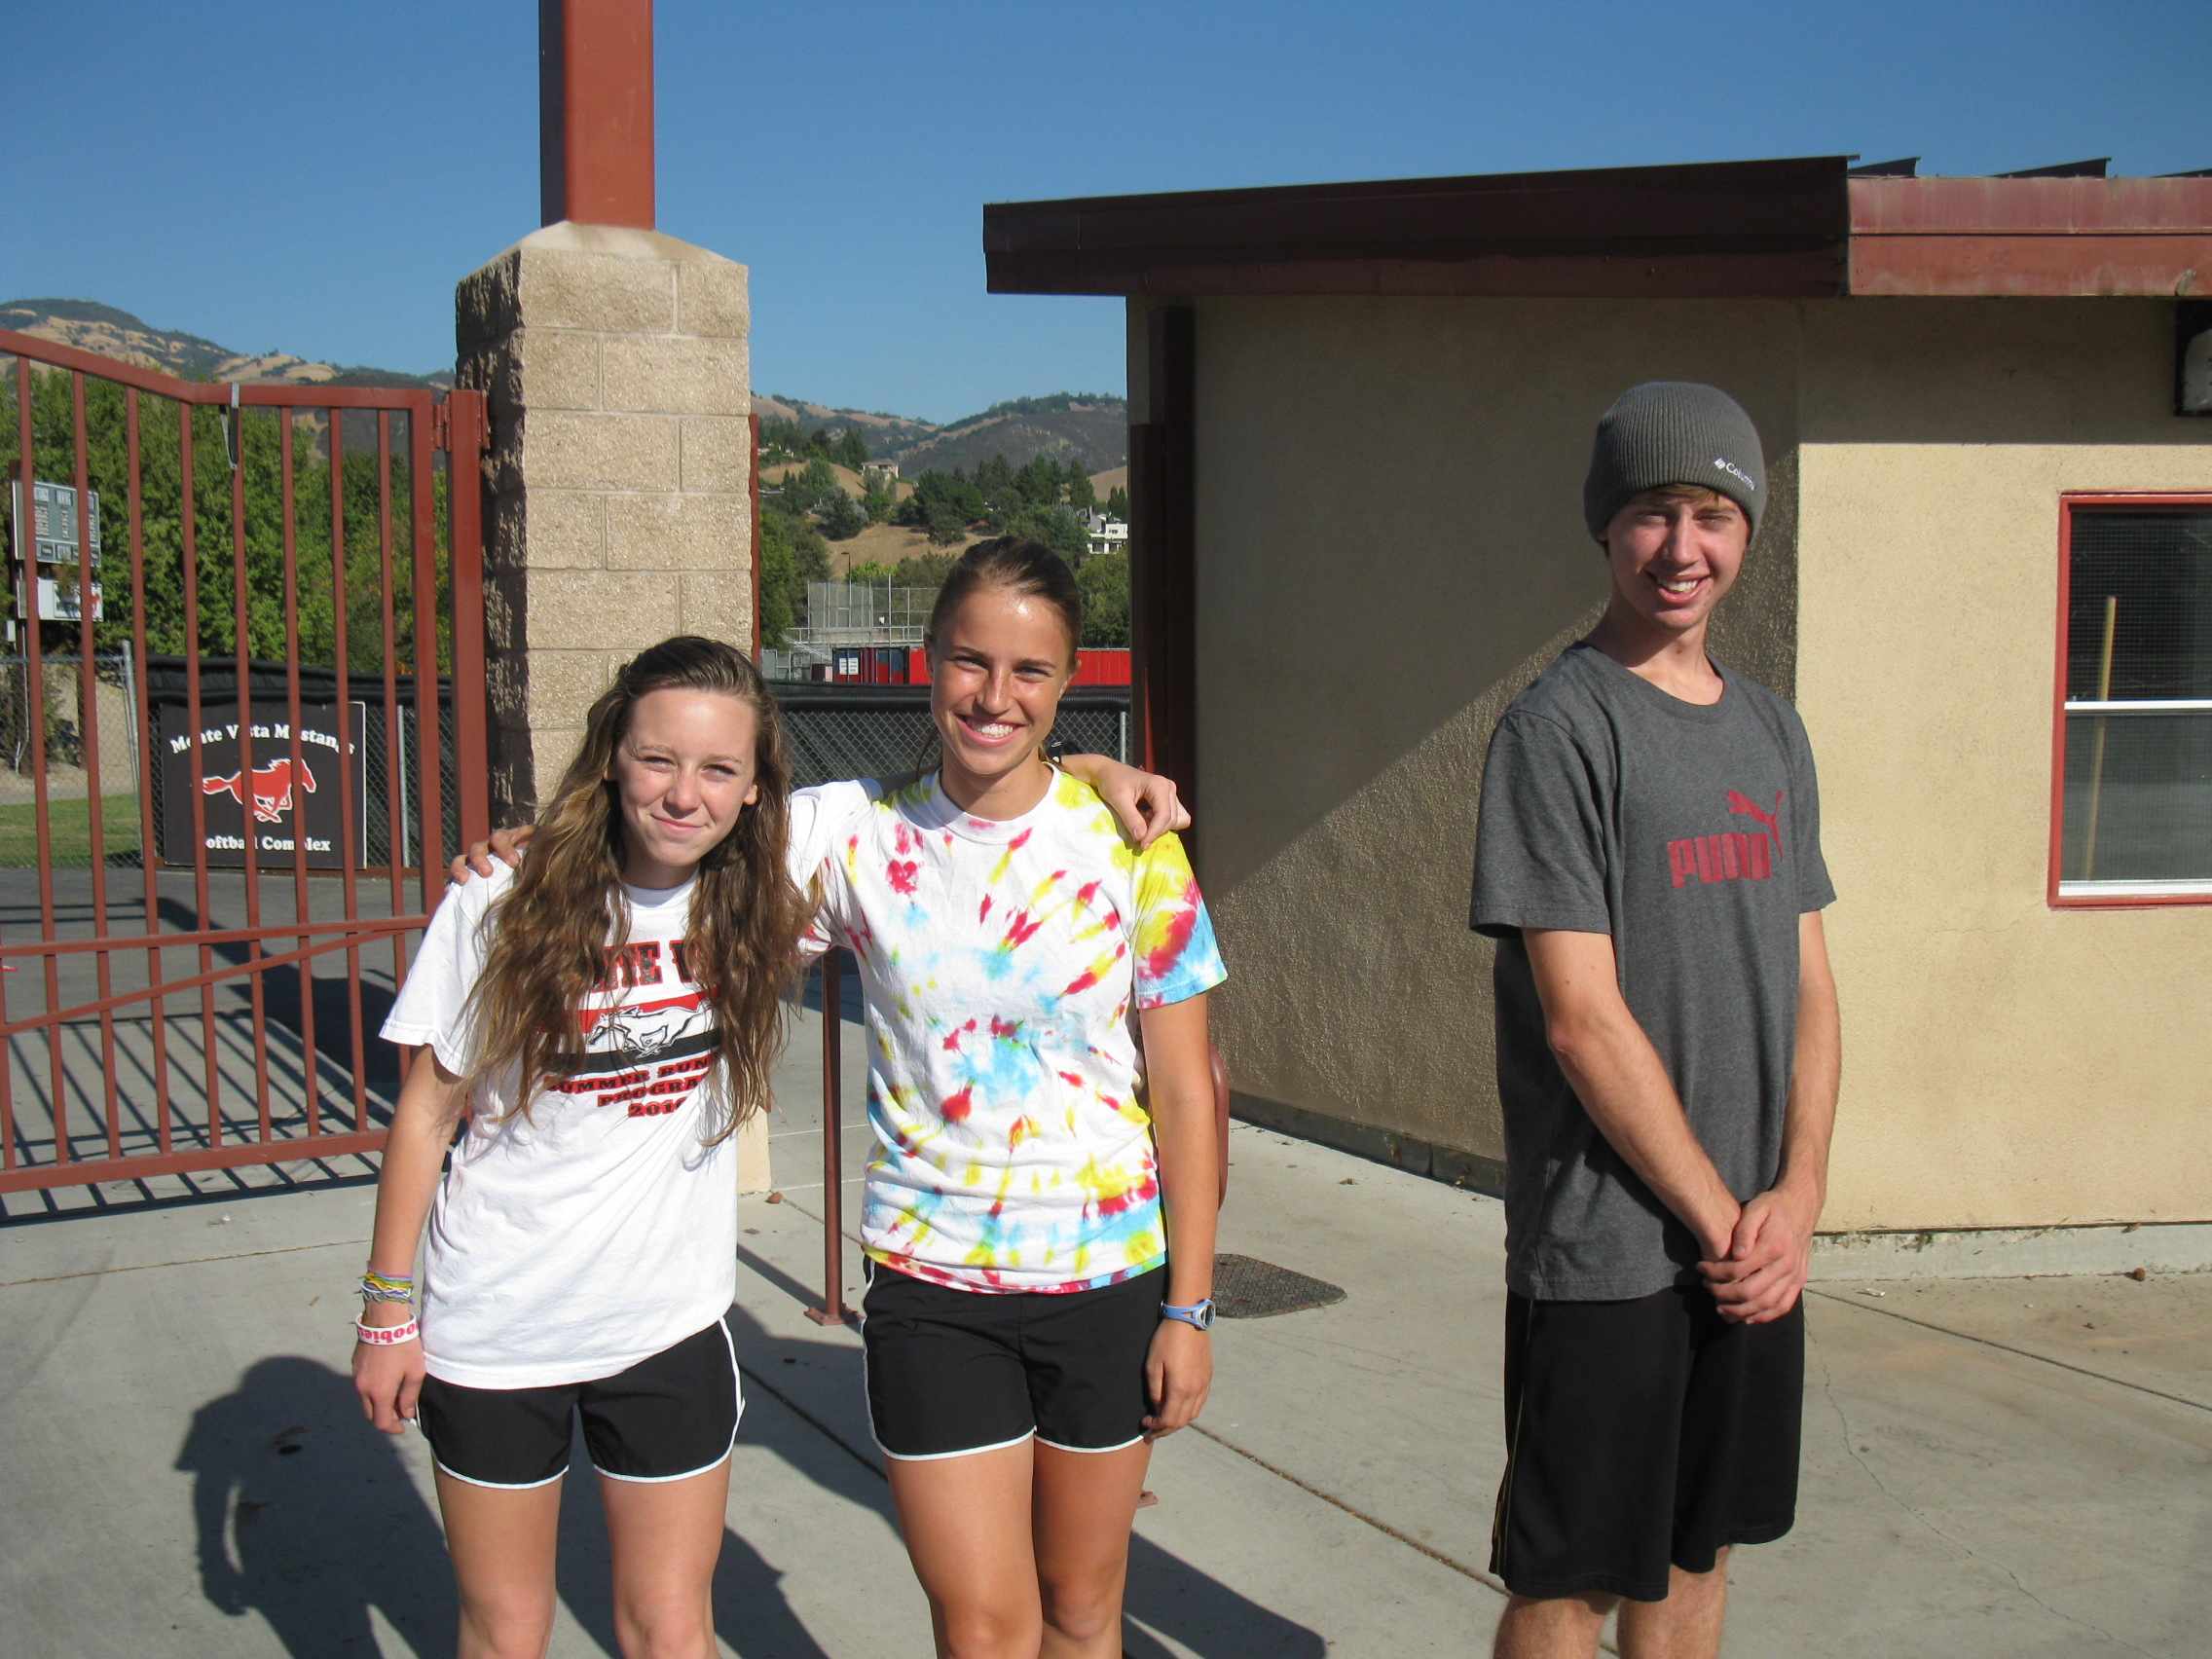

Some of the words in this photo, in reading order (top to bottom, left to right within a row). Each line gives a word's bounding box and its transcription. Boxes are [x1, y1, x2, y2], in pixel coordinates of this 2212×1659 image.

[226, 724, 270, 738] Vta
[275, 723, 355, 755] Mstans
[203, 835, 258, 850] oftbal
[262, 836, 331, 851] Comlex
[1667, 833, 1771, 888] PUMA
[597, 1071, 708, 1107] PROGRA
